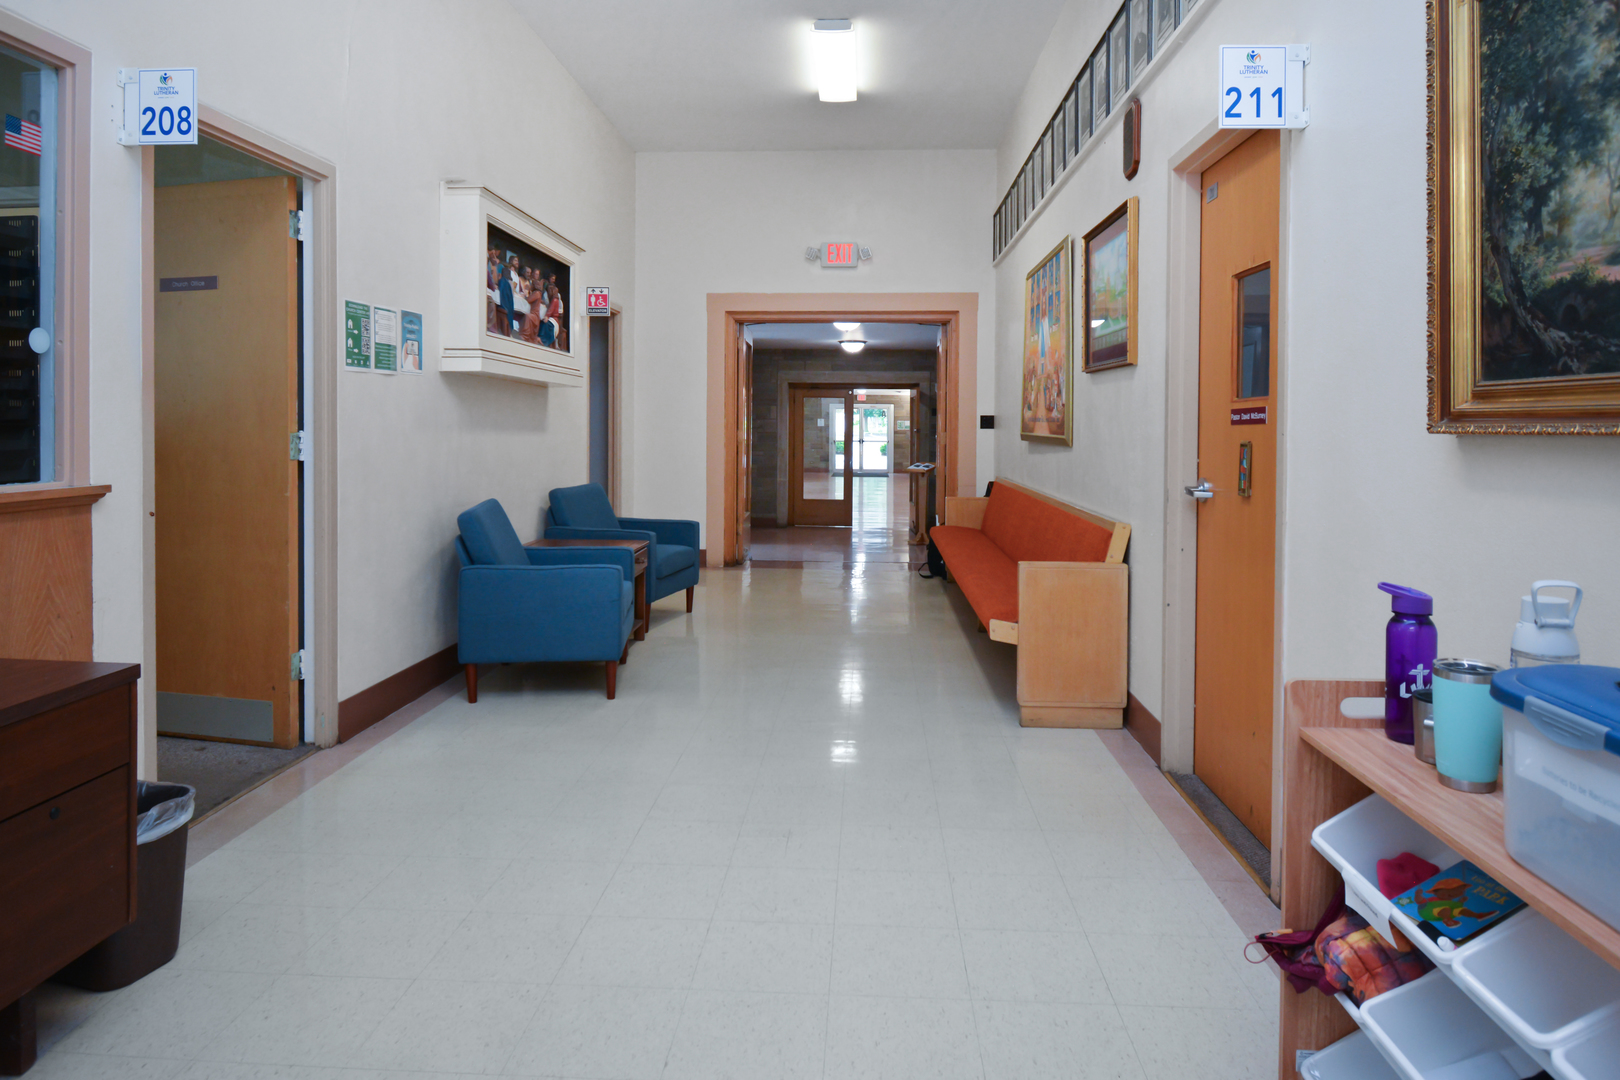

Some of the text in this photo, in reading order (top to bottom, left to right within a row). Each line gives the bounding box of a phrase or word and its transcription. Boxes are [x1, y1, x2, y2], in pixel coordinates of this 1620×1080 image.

[1225, 86, 1283, 118] 211
[141, 106, 192, 136] 208
[827, 243, 854, 264] EXIT
[1241, 412, 1250, 420] David
[1472, 885, 1510, 905] PARK
